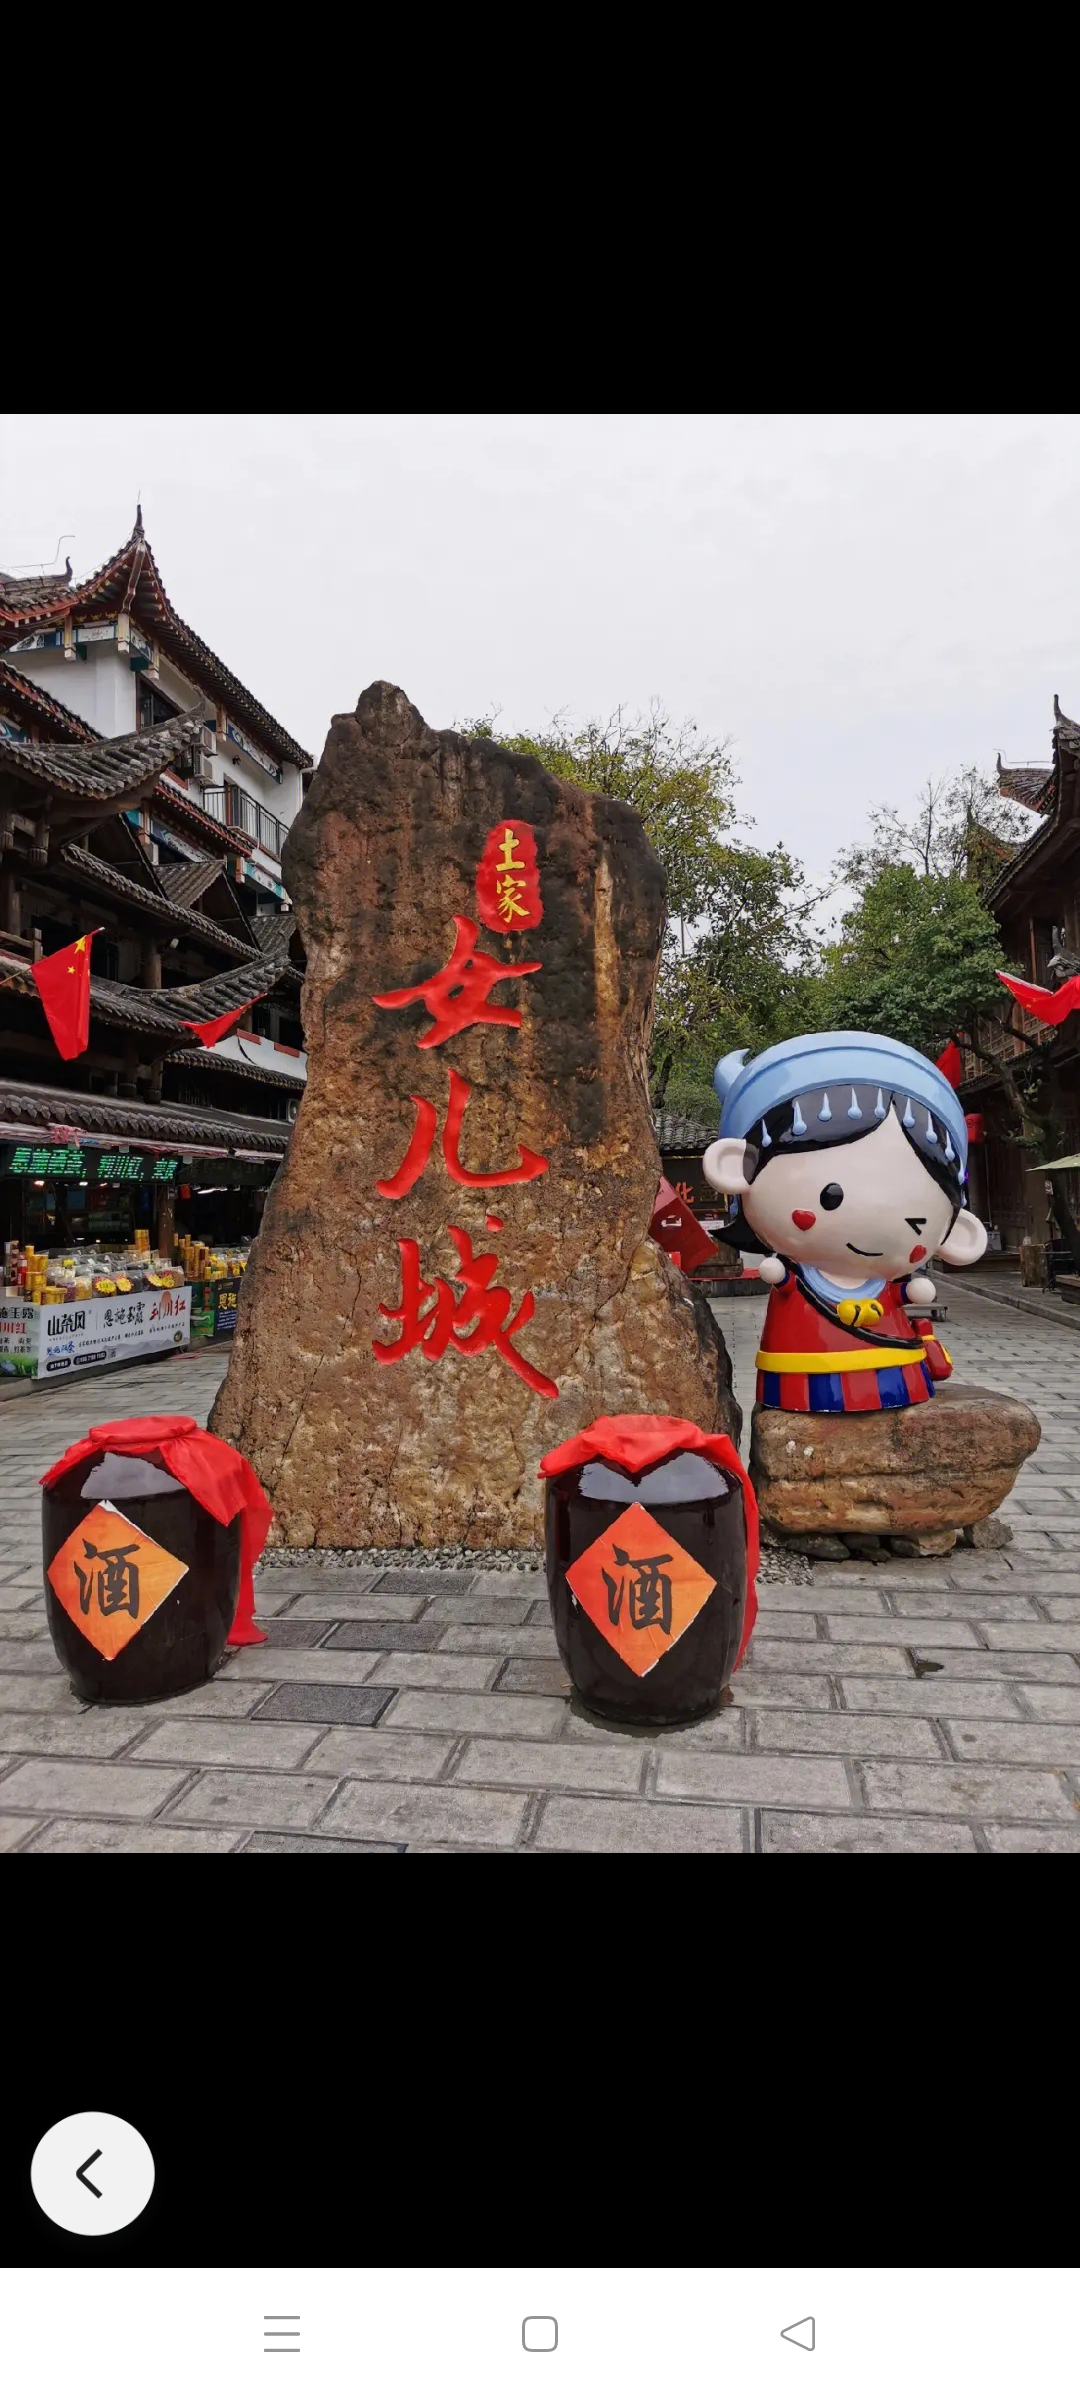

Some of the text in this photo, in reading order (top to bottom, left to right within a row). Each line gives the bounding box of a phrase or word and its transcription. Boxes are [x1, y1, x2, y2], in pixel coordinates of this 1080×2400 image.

[495, 828, 530, 922] 土家
[371, 914, 560, 1399] 女儿城
[47, 1310, 86, 1337] 山茶风
[74, 1537, 141, 1620] 酒
[601, 1543, 674, 1635] 酒
